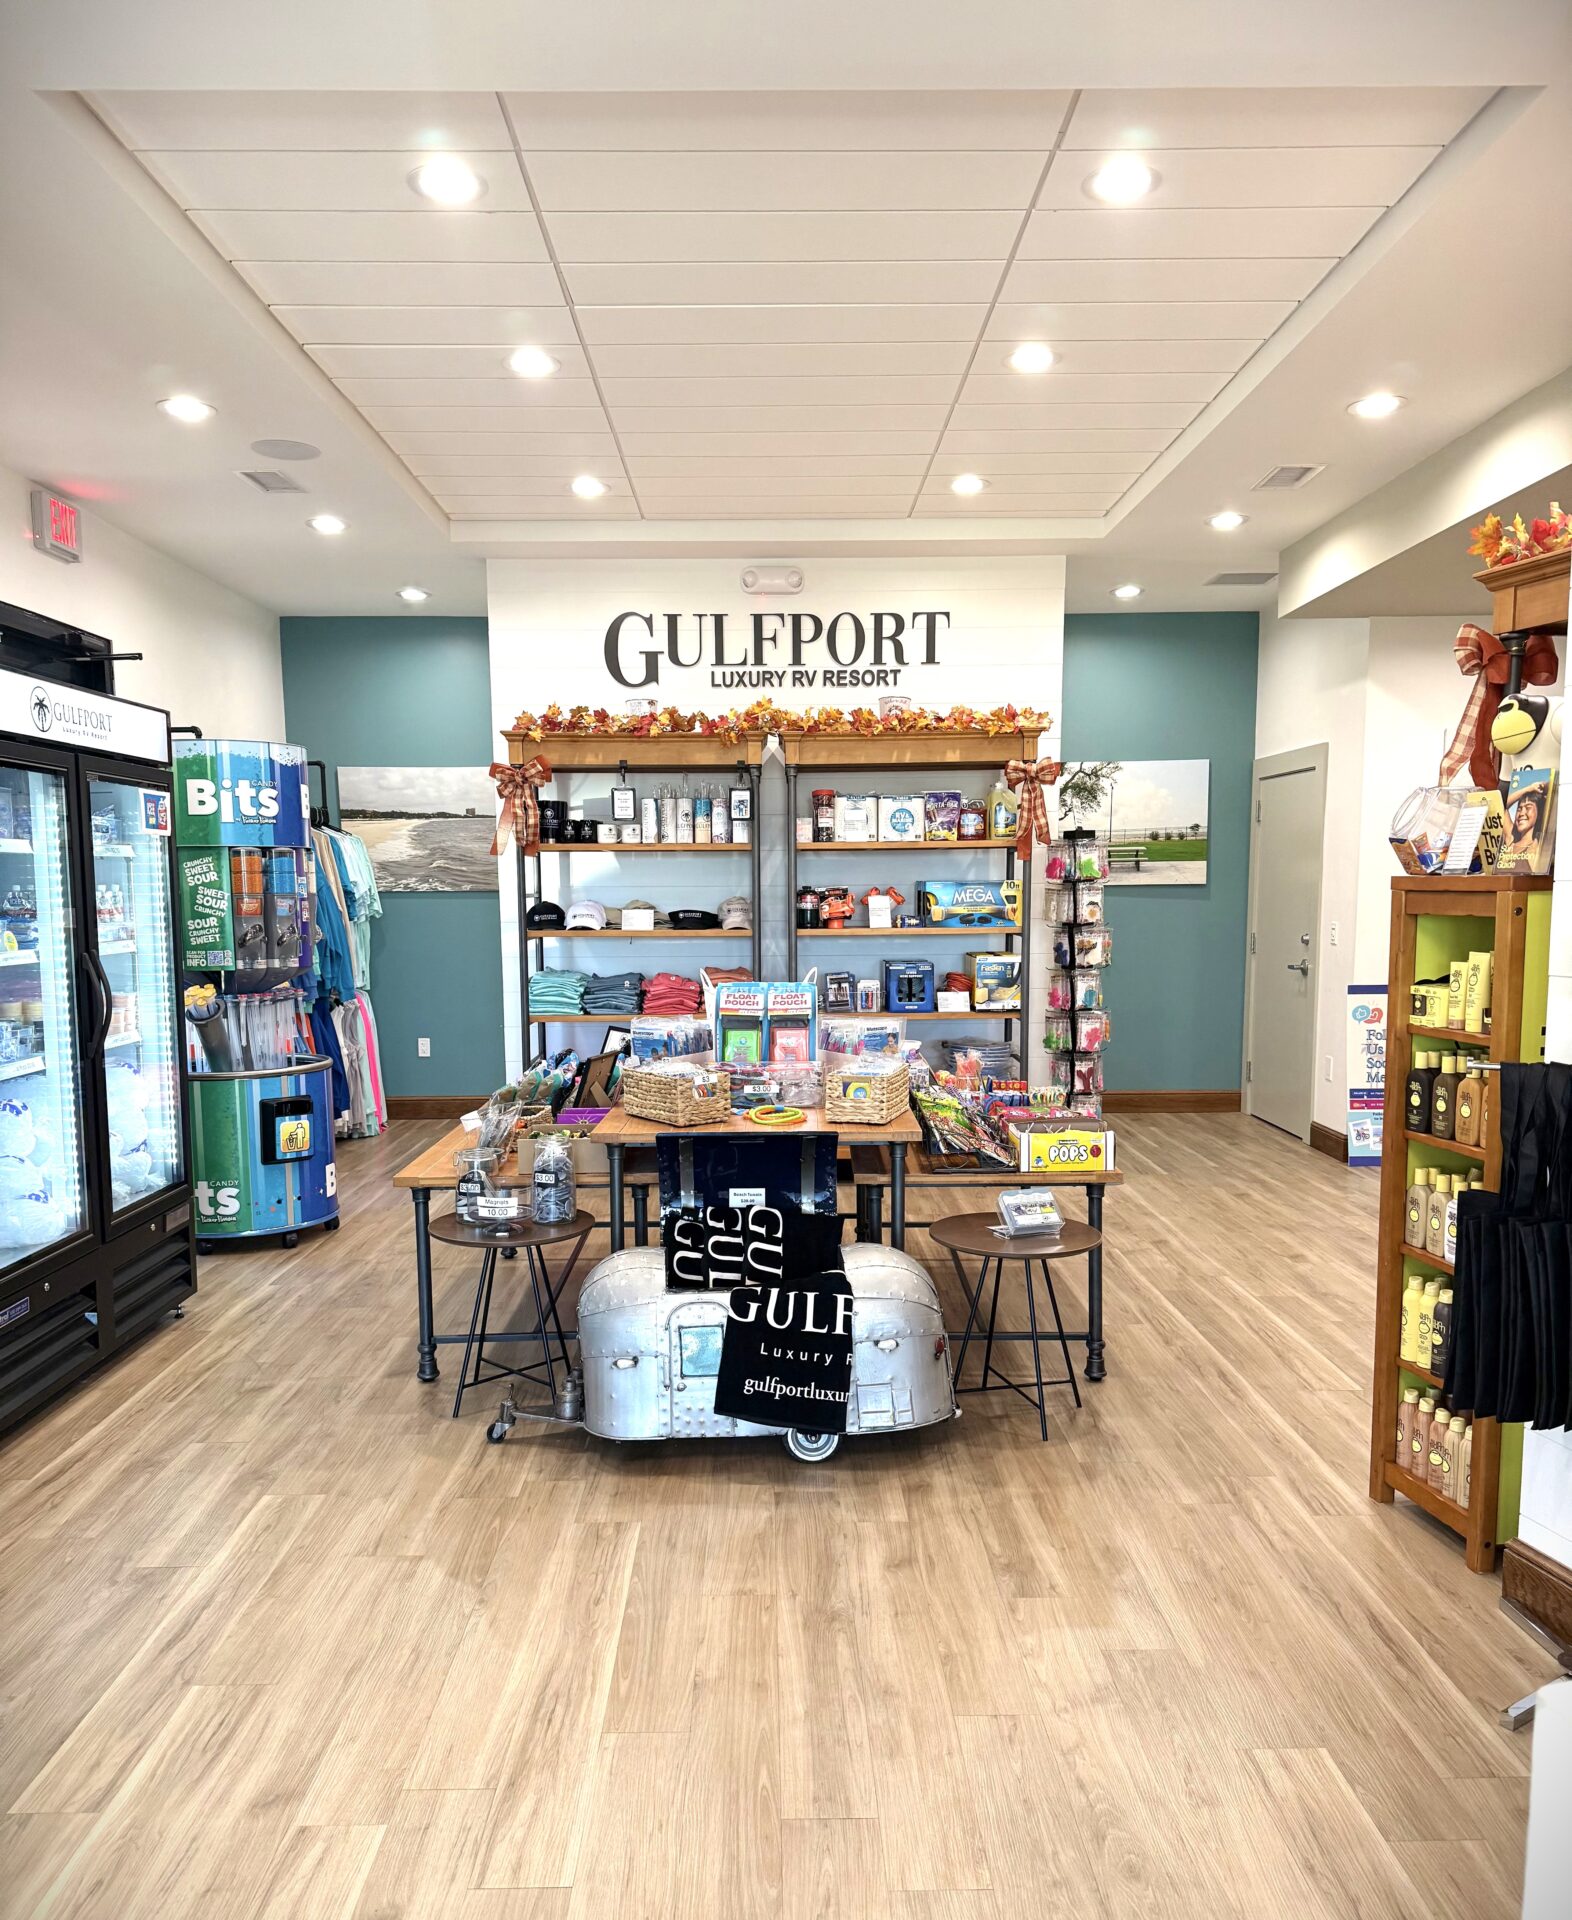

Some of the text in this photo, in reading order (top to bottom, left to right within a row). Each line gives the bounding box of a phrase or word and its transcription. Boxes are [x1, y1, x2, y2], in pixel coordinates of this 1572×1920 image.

[50, 498, 77, 548] EXIT
[604, 611, 950, 688] GULFPORT
[711, 669, 901, 688] LUXURY RV RESORT
[53, 702, 113, 732] GULFPORT
[186, 778, 280, 823] Bits
[183, 856, 213, 868] CRUNCHY
[184, 863, 215, 877] SWEET
[187, 871, 219, 886] SOUR
[1005, 881, 1015, 889] 10
[197, 886, 230, 901] SWEET
[953, 888, 995, 904] MEGA
[195, 894, 228, 910] SOUR
[194, 905, 226, 917] CRUNCHY
[187, 917, 218, 930] SOUR
[189, 928, 219, 937] CRUNCHY
[190, 934, 220, 945] SWEET
[186, 959, 207, 967] INFO
[1366, 1044, 1384, 1055] Us
[1049, 1145, 1088, 1162] POPS
[535, 1174, 554, 1182] $3.00
[760, 1342, 833, 1366] Luxury
